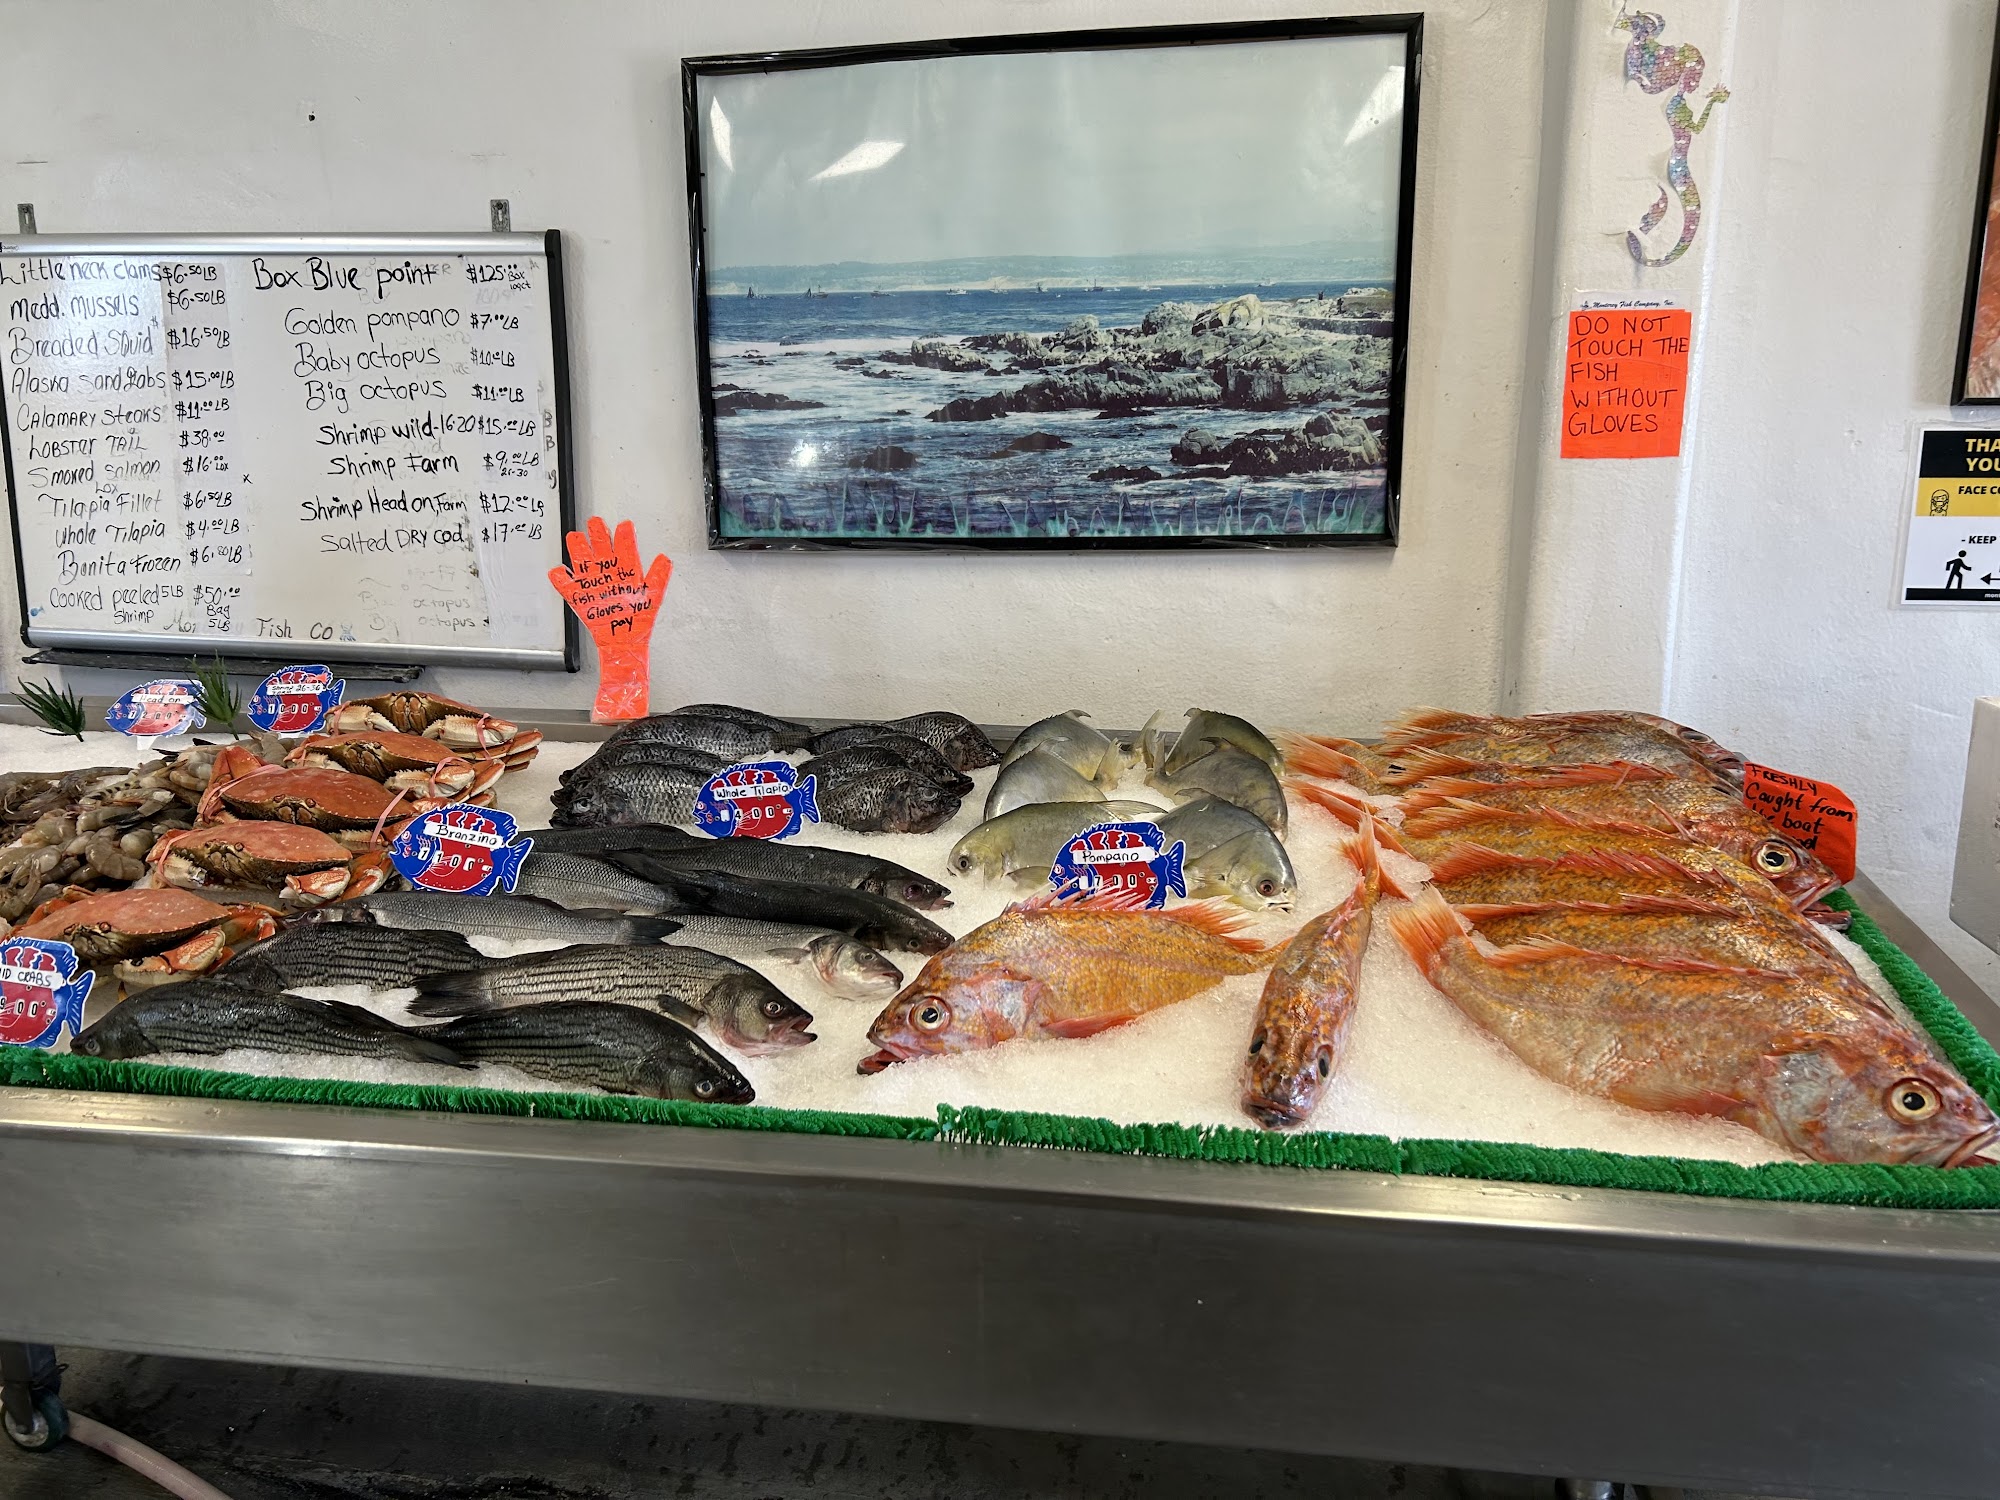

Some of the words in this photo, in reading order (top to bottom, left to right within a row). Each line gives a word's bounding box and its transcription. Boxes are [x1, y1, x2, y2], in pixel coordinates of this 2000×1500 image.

[0, 257, 66, 285] Little
[252, 258, 302, 290] Box
[306, 257, 362, 291] Blue
[377, 261, 436, 299] point
[1592, 301, 1618, 309] Monterey
[285, 307, 357, 335] Golden
[1575, 315, 1609, 336] DO
[1623, 316, 1671, 335] NOT
[8, 327, 98, 365] Breaded
[1570, 338, 1643, 358] TOUCH
[1652, 336, 1689, 355] THE
[294, 342, 350, 377] Baby
[357, 342, 441, 370] octopus
[11, 367, 69, 402] Alaska
[1570, 362, 1618, 383] FISH
[305, 381, 349, 414] Big
[360, 376, 447, 400] octopus
[1571, 388, 1678, 408] WITHOUT
[316, 422, 386, 446] Shrimp
[1568, 412, 1658, 436] GLOVES
[28, 460, 94, 488] Smoked
[327, 452, 395, 481] Shrimp
[403, 453, 459, 474] Farm
[1958, 485, 1987, 494] FACE
[38, 493, 110, 520] Tilapia
[300, 495, 363, 521] Shrimp
[367, 486, 410, 514] Head
[105, 519, 165, 544] Tilapia
[320, 529, 394, 554] Salted
[395, 529, 428, 548] DRY
[1968, 535, 1997, 545] KEEP
[575, 574, 613, 590] Touch
[599, 582, 650, 600] without
[49, 586, 103, 612] Cooked
[112, 584, 160, 611] peeled
[206, 604, 230, 620] Bag
[586, 603, 624, 620] Gloves
[257, 617, 293, 638] Fish
[610, 616, 634, 636] pay
[1745, 763, 1817, 796] FRESHLY
[1745, 782, 1804, 812] Caught
[1809, 798, 1853, 822] from
[1782, 811, 1824, 834] boat
[436, 824, 498, 846] Branzino
[1083, 851, 1139, 864] Pompano
[18, 971, 53, 987] CRABS
